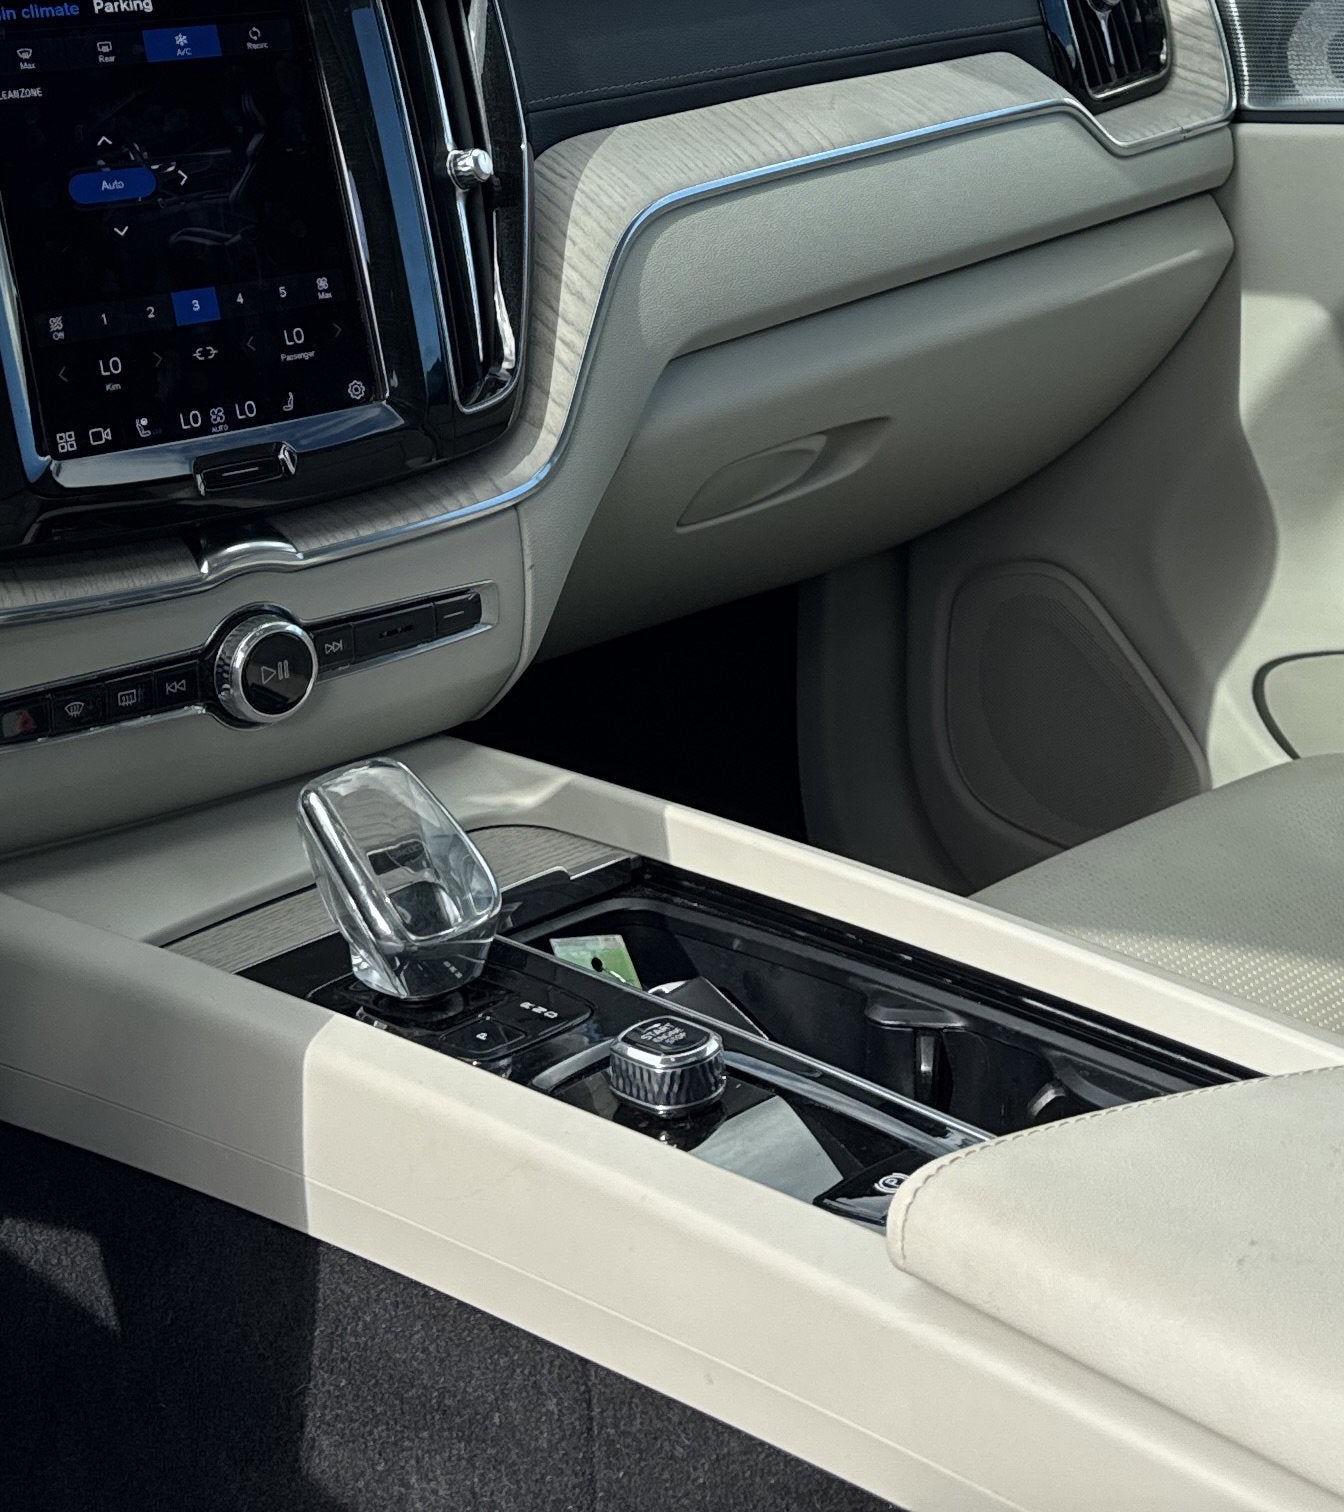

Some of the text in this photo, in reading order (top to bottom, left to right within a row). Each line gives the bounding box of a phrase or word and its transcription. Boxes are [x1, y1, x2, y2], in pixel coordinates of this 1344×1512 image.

[21, 2, 80, 20] climate
[176, 48, 192, 56] A/C
[99, 55, 116, 63] Rear
[102, 179, 125, 191] Auto
[101, 286, 287, 325] 1 2 3 4 5
[284, 327, 305, 346] LO
[280, 350, 315, 362] Passenger
[99, 356, 122, 376] LO
[179, 401, 256, 430] LO LO
[212, 424, 229, 433] AUTO
[476, 1032, 488, 1041] P
[641, 1022, 675, 1041] START
[665, 1032, 687, 1044] STOP
